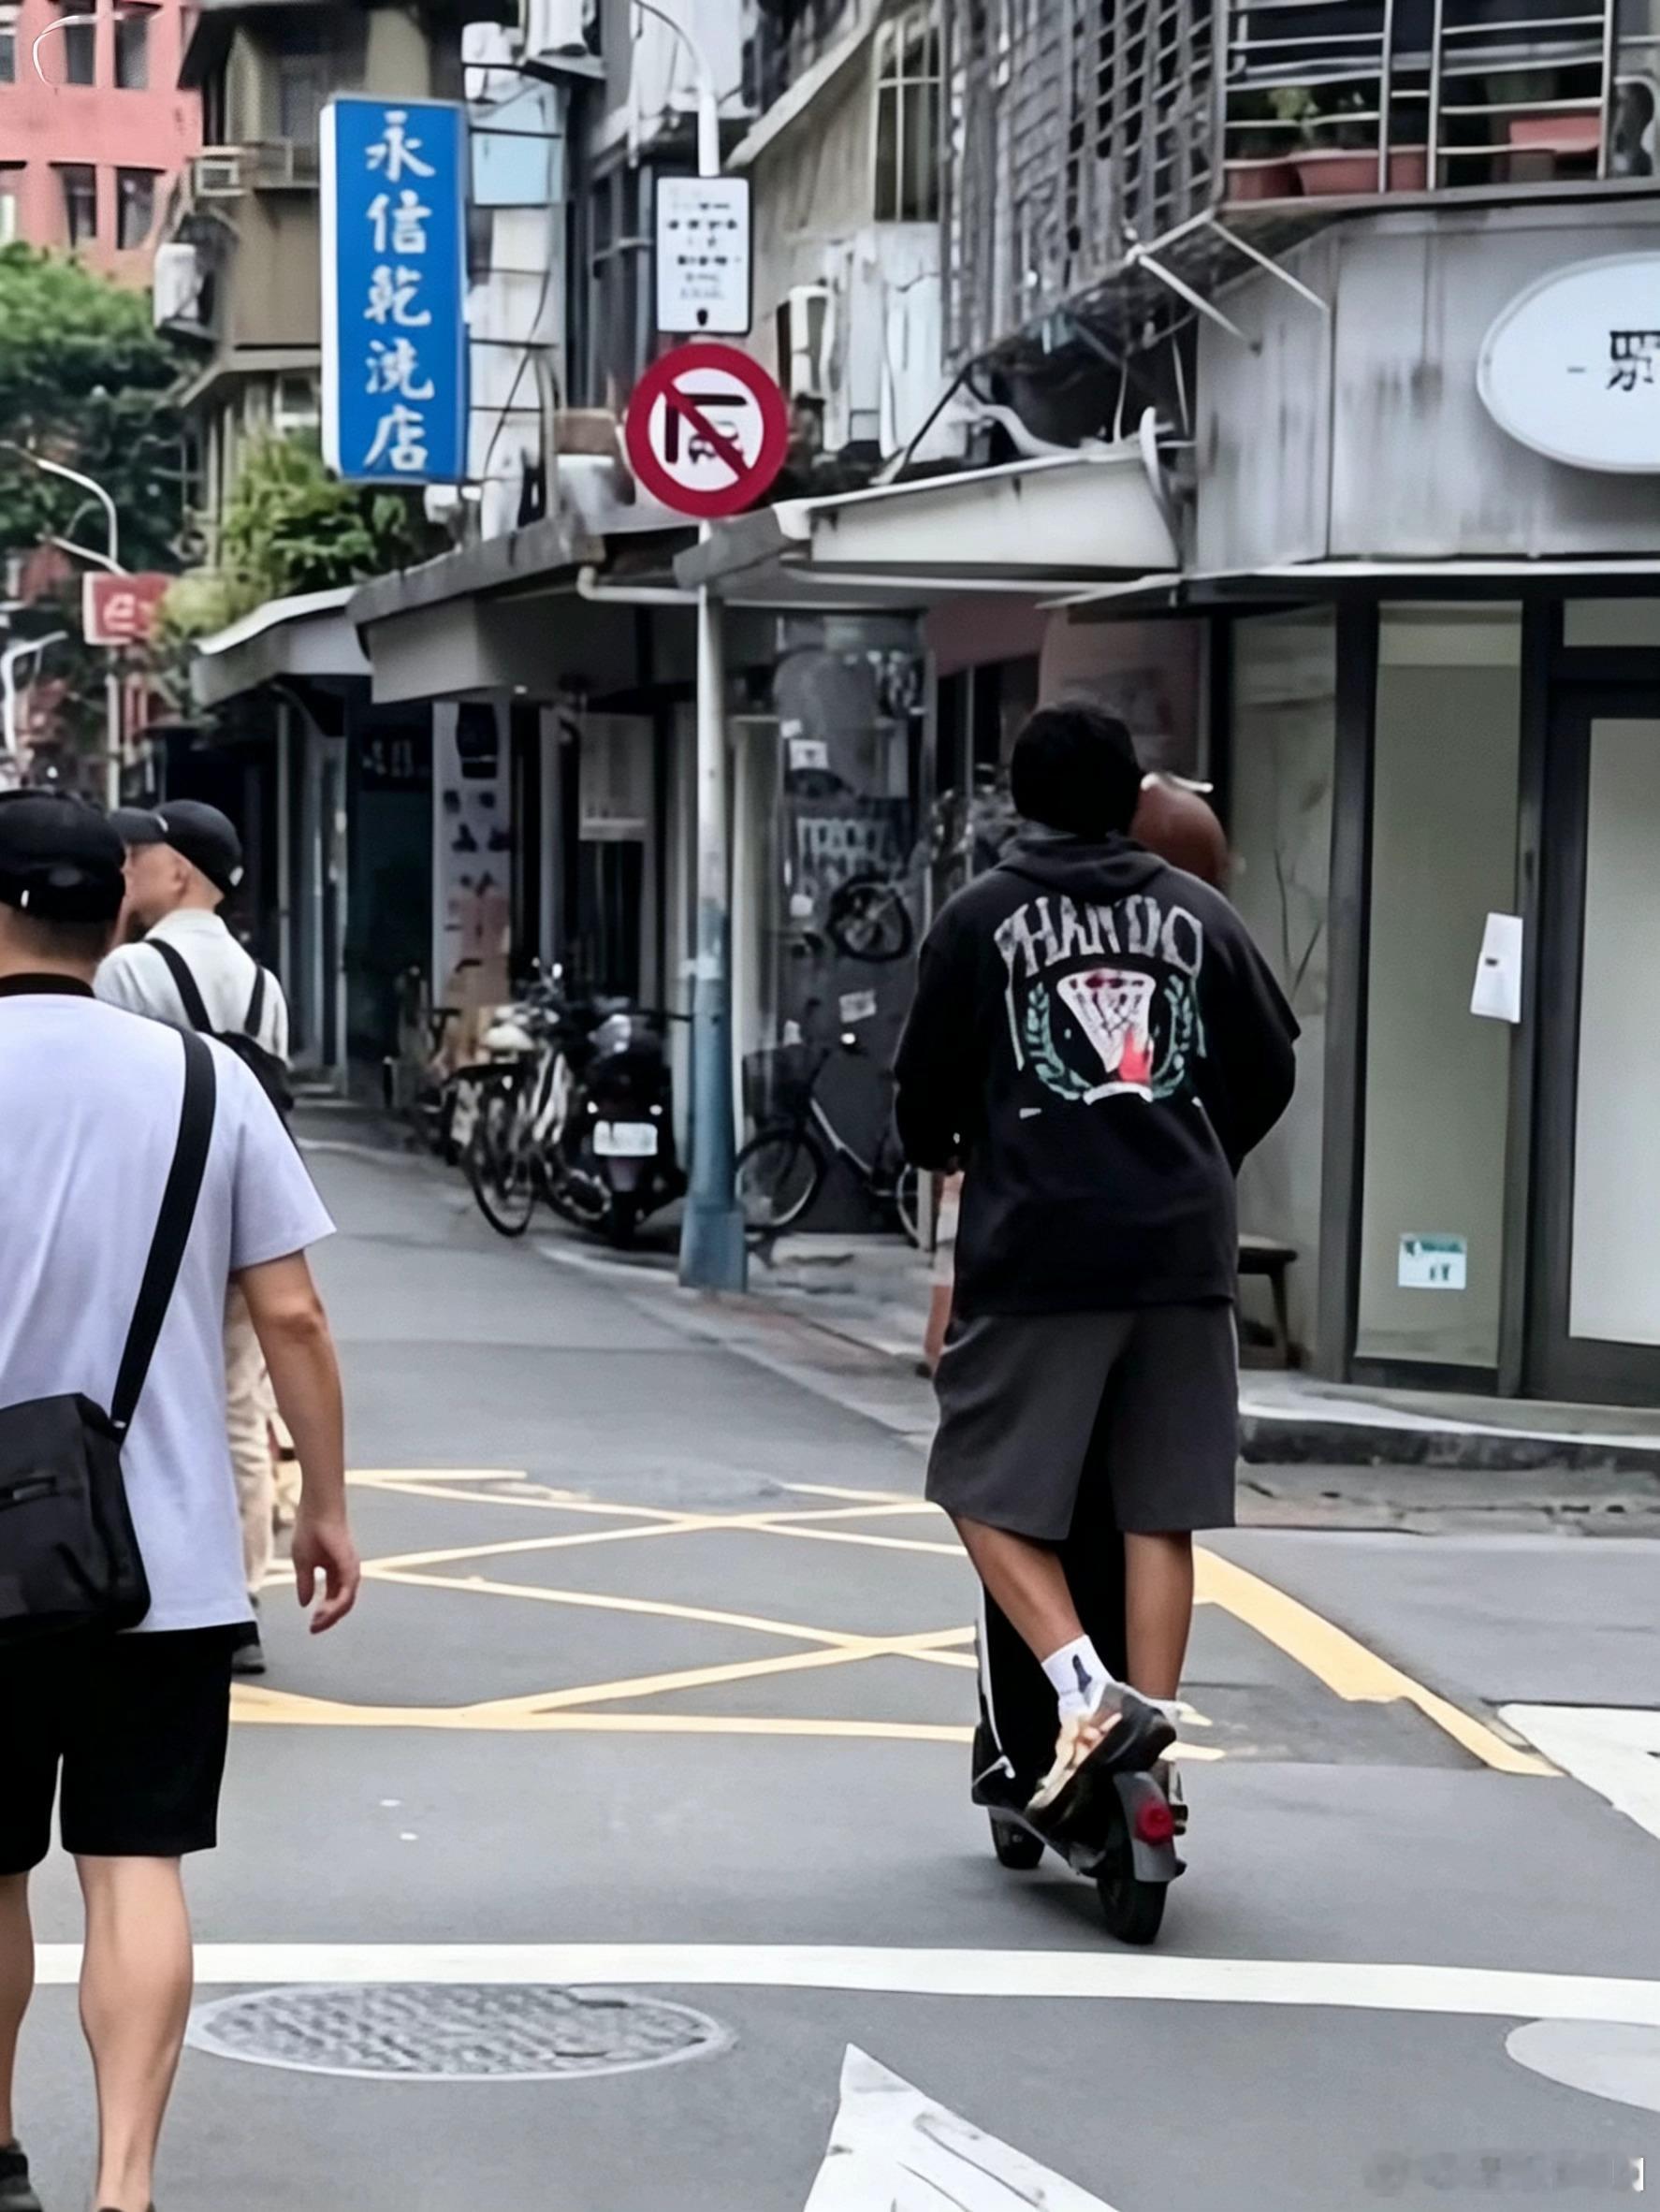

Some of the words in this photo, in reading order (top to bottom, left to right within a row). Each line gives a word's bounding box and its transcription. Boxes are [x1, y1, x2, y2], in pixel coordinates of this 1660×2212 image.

[363, 109, 436, 472] 永信乾洗店
